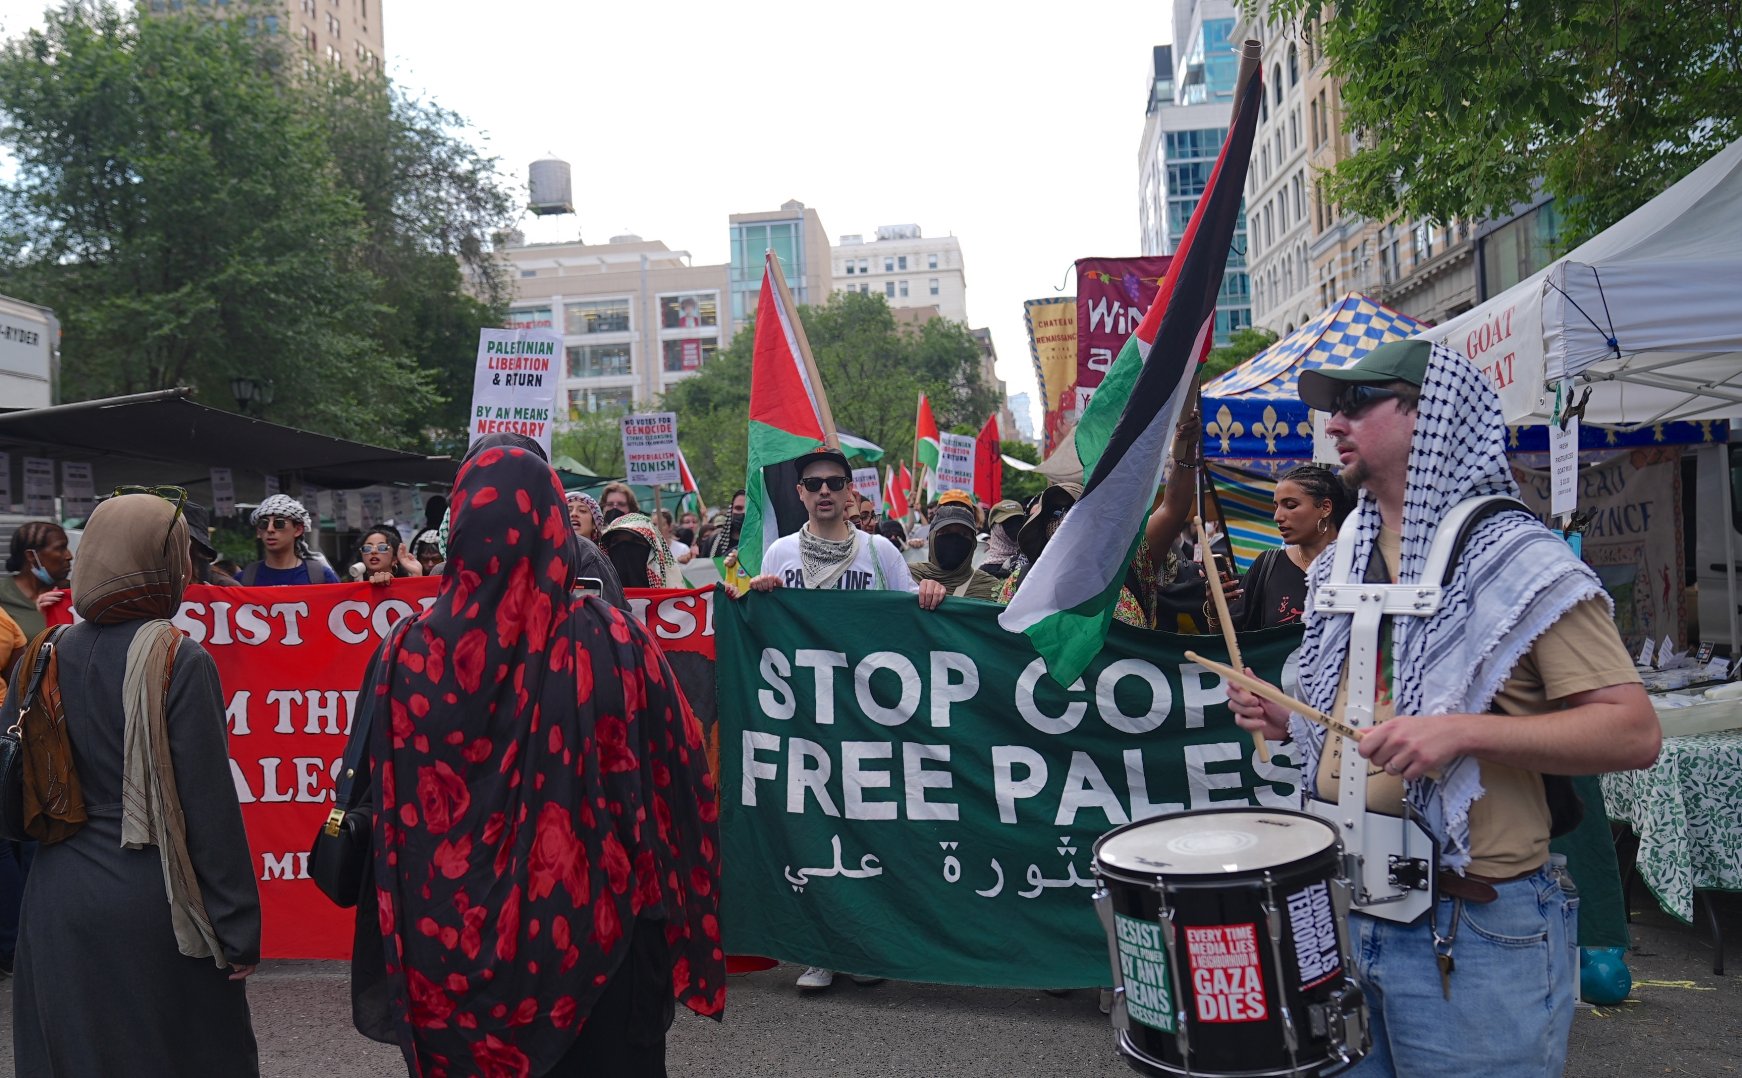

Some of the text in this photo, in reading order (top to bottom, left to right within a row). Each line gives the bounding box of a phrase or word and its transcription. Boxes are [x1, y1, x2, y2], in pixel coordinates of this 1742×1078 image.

[1038, 318, 1073, 328] CHATEAU
[1466, 305, 1516, 360] GOAT
[0, 325, 40, 346] -RYDER
[1036, 333, 1077, 345] RENAISSANC
[487, 340, 555, 355] PALETINIAN
[488, 356, 550, 371] LIBEATION
[492, 372, 543, 387] & RTURN
[476, 405, 549, 421] BY AN MEANS
[636, 418, 656, 426] VOTES
[626, 424, 672, 435] GENOCIDE
[629, 452, 674, 461] IMPERIALISM
[630, 460, 676, 472] ZIONISM
[757, 647, 980, 728] STOP
[741, 729, 960, 822] FREE
[1114, 913, 1161, 950] RESIST
[1186, 925, 1254, 943] EVERY TIME
[1285, 886, 1324, 983] TERRORISM
[1308, 879, 1340, 973] ZIONISM IS
[1189, 939, 1256, 955] MEDIA LIES
[1135, 959, 1166, 989] ANY
[1193, 965, 1262, 995] GAZA
[1123, 975, 1172, 1014] MEANS
[1126, 999, 1173, 1031] NECESSARY
[1196, 991, 1266, 1021] DIES
